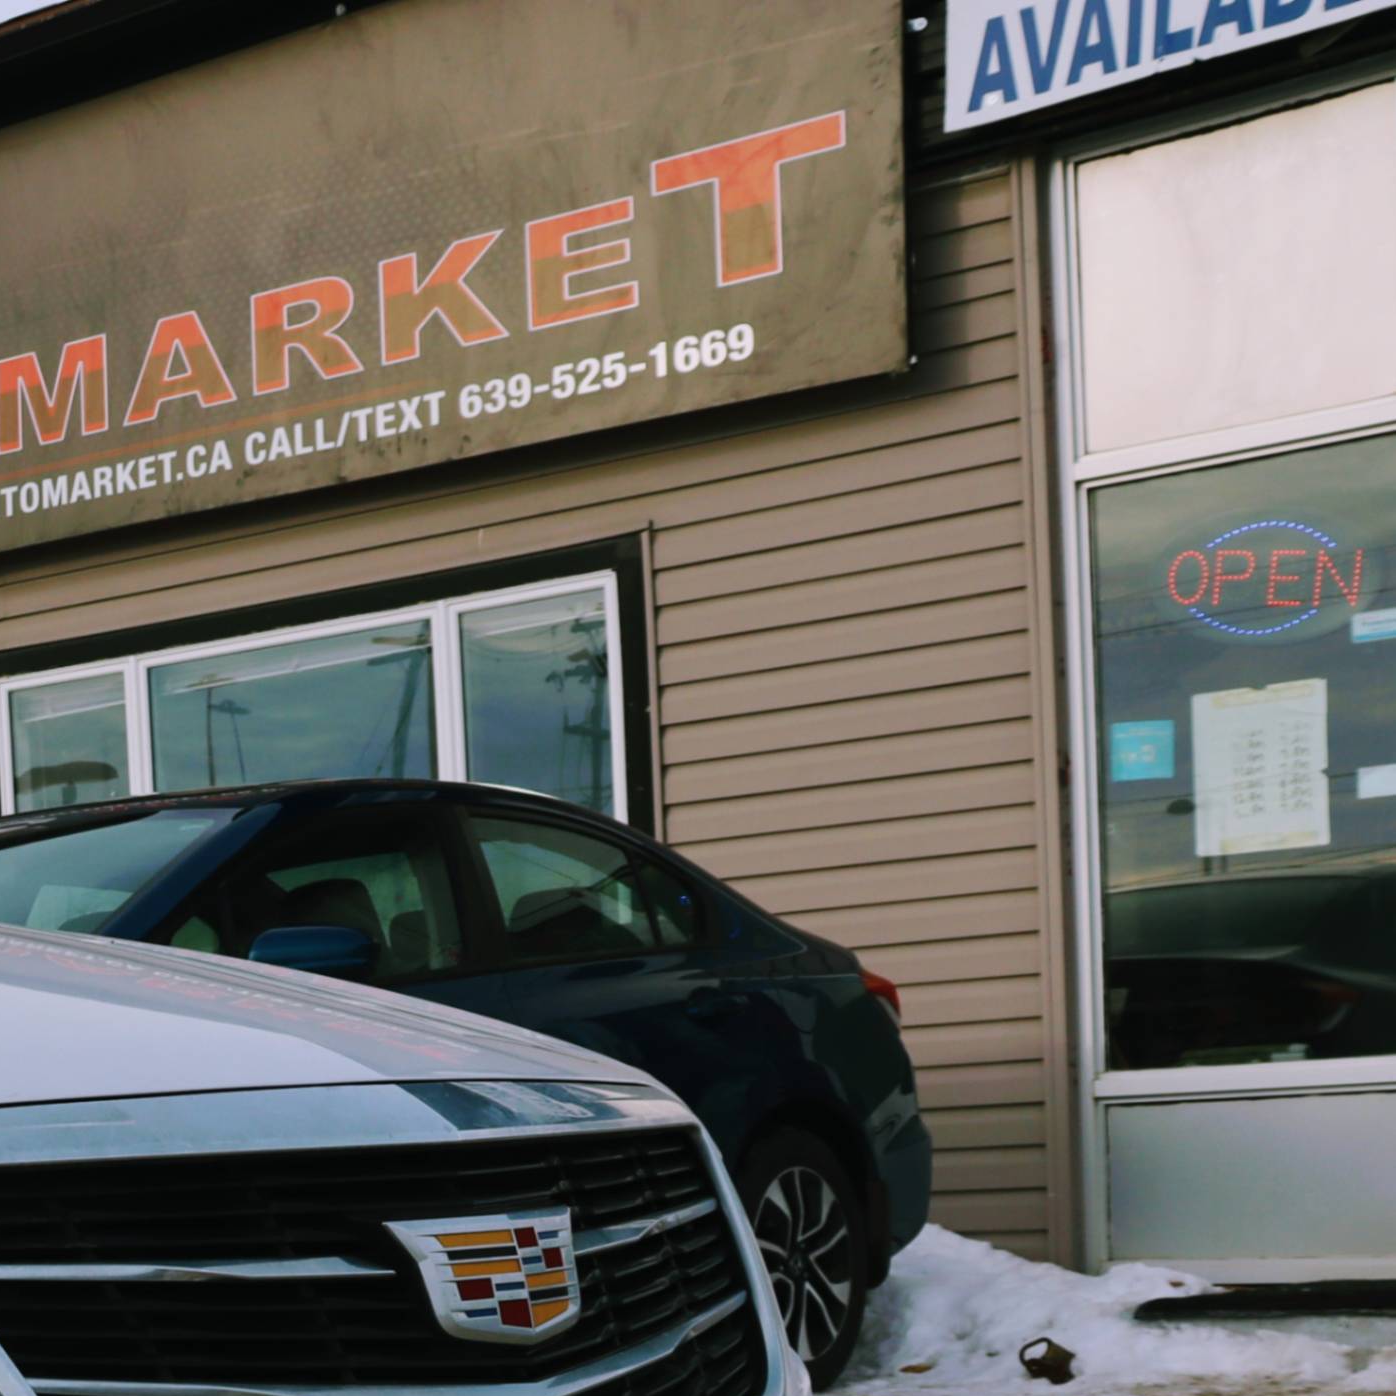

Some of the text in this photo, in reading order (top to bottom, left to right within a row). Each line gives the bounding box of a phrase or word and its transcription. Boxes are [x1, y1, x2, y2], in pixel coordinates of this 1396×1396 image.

[244, 391, 446, 466] CALL/TEXT
[458, 323, 756, 419] 639-525-1669
[1168, 548, 1363, 608] OPEN
